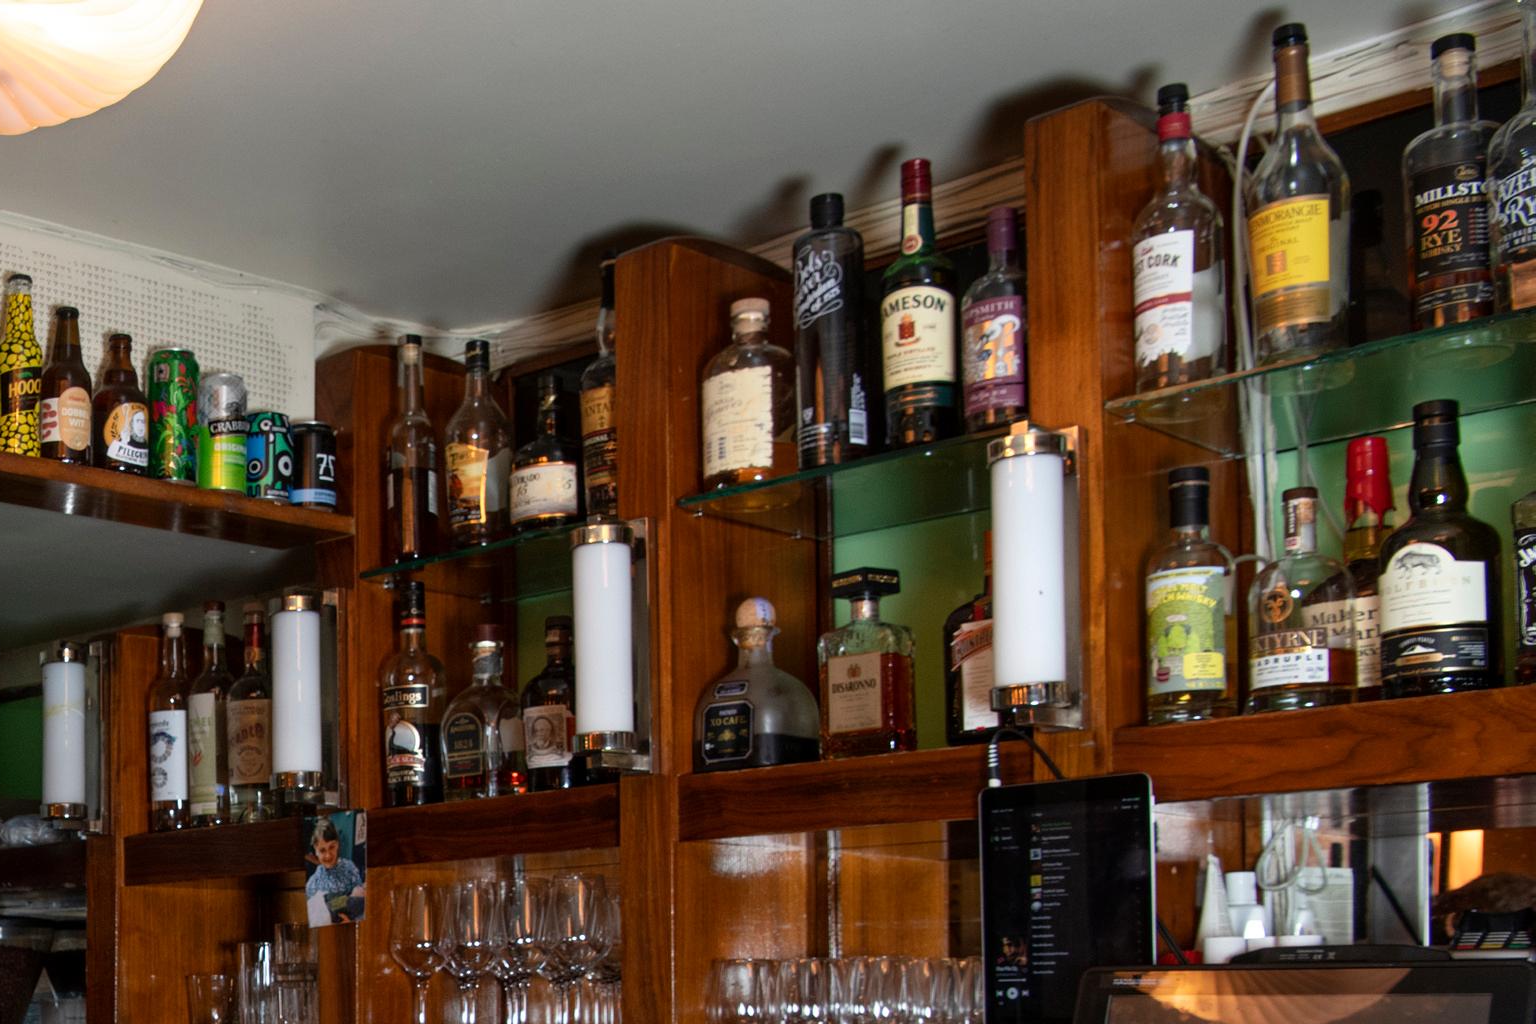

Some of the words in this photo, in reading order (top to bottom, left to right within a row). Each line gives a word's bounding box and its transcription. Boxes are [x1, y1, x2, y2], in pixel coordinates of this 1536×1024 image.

[1421, 209, 1460, 237] 92
[1421, 228, 1462, 250] RYE
[1147, 252, 1181, 270] CORK
[831, 678, 878, 695] DISARONNO
